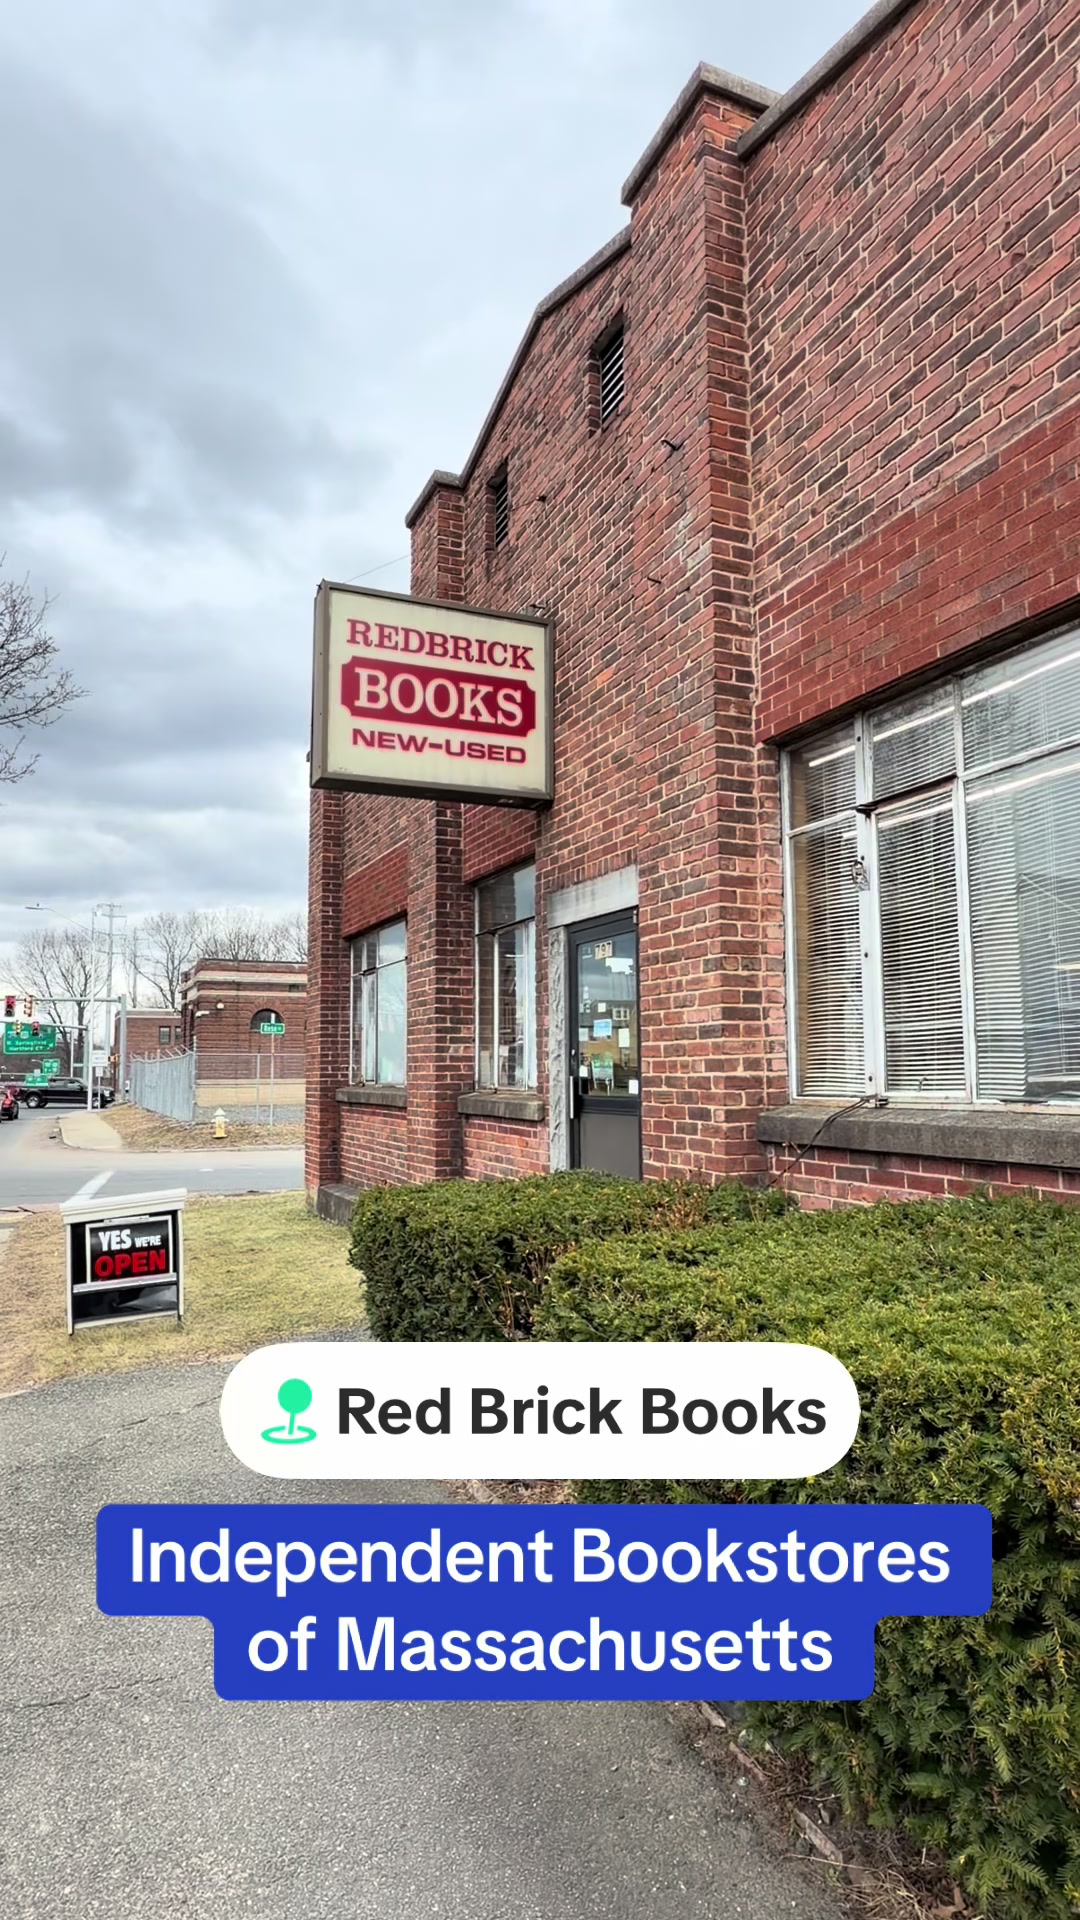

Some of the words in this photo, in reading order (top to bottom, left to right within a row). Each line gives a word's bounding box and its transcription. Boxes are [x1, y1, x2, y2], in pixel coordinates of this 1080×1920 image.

[346, 618, 535, 671] REDBRICK
[354, 667, 523, 727] BOOKS
[352, 728, 527, 764] NEW-USED
[595, 942, 611, 958] 797
[98, 1229, 132, 1252] YES
[134, 1235, 162, 1248] WE'RE
[95, 1249, 166, 1277] OPEN
